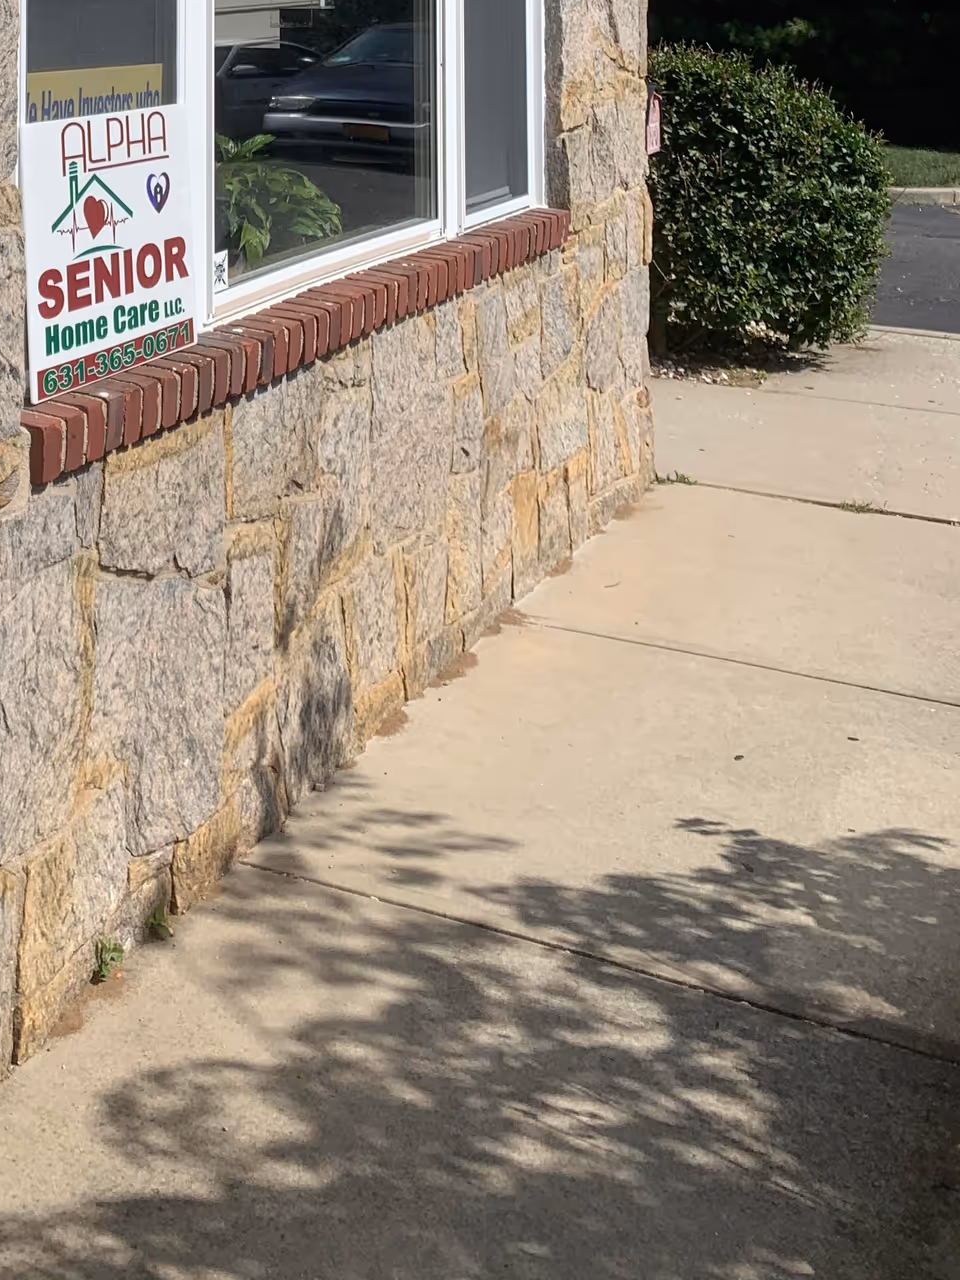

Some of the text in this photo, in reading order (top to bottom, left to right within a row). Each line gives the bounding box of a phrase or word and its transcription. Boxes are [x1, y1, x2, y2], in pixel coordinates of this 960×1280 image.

[41, 90, 75, 121] Have
[78, 86, 133, 117] Investors
[135, 80, 160, 111] who
[60, 111, 167, 177] ALPHA
[37, 235, 190, 320] SENIOR
[43, 321, 191, 396] 631-365-0671
[45, 297, 186, 357] Home Care LLC.
